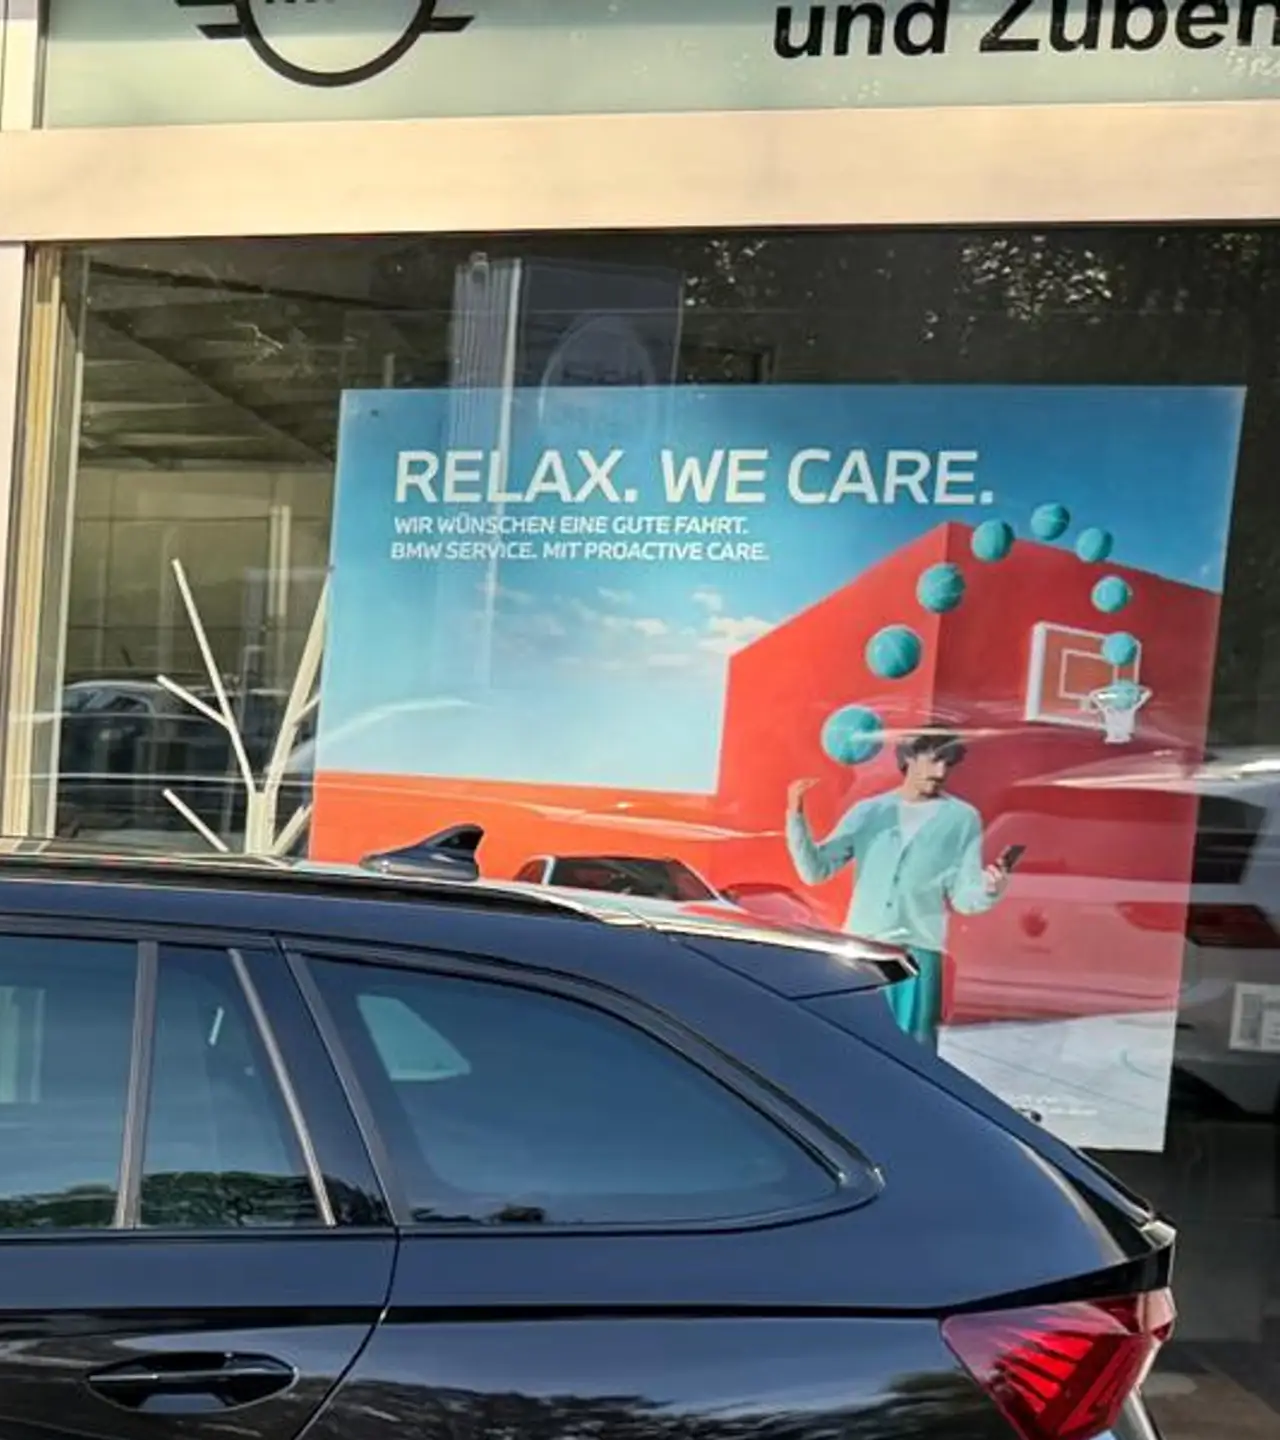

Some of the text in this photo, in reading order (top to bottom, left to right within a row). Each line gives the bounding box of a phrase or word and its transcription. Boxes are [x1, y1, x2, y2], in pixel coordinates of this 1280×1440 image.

[773, 0, 951, 58] und
[394, 448, 994, 505] RELAX. WE CARE.
[393, 511, 749, 534] WIR WÜNSCHEN EINE GUTE FAHRT.
[391, 541, 770, 561] BMW SERVICE. MIT PROACTIVE CARE.
